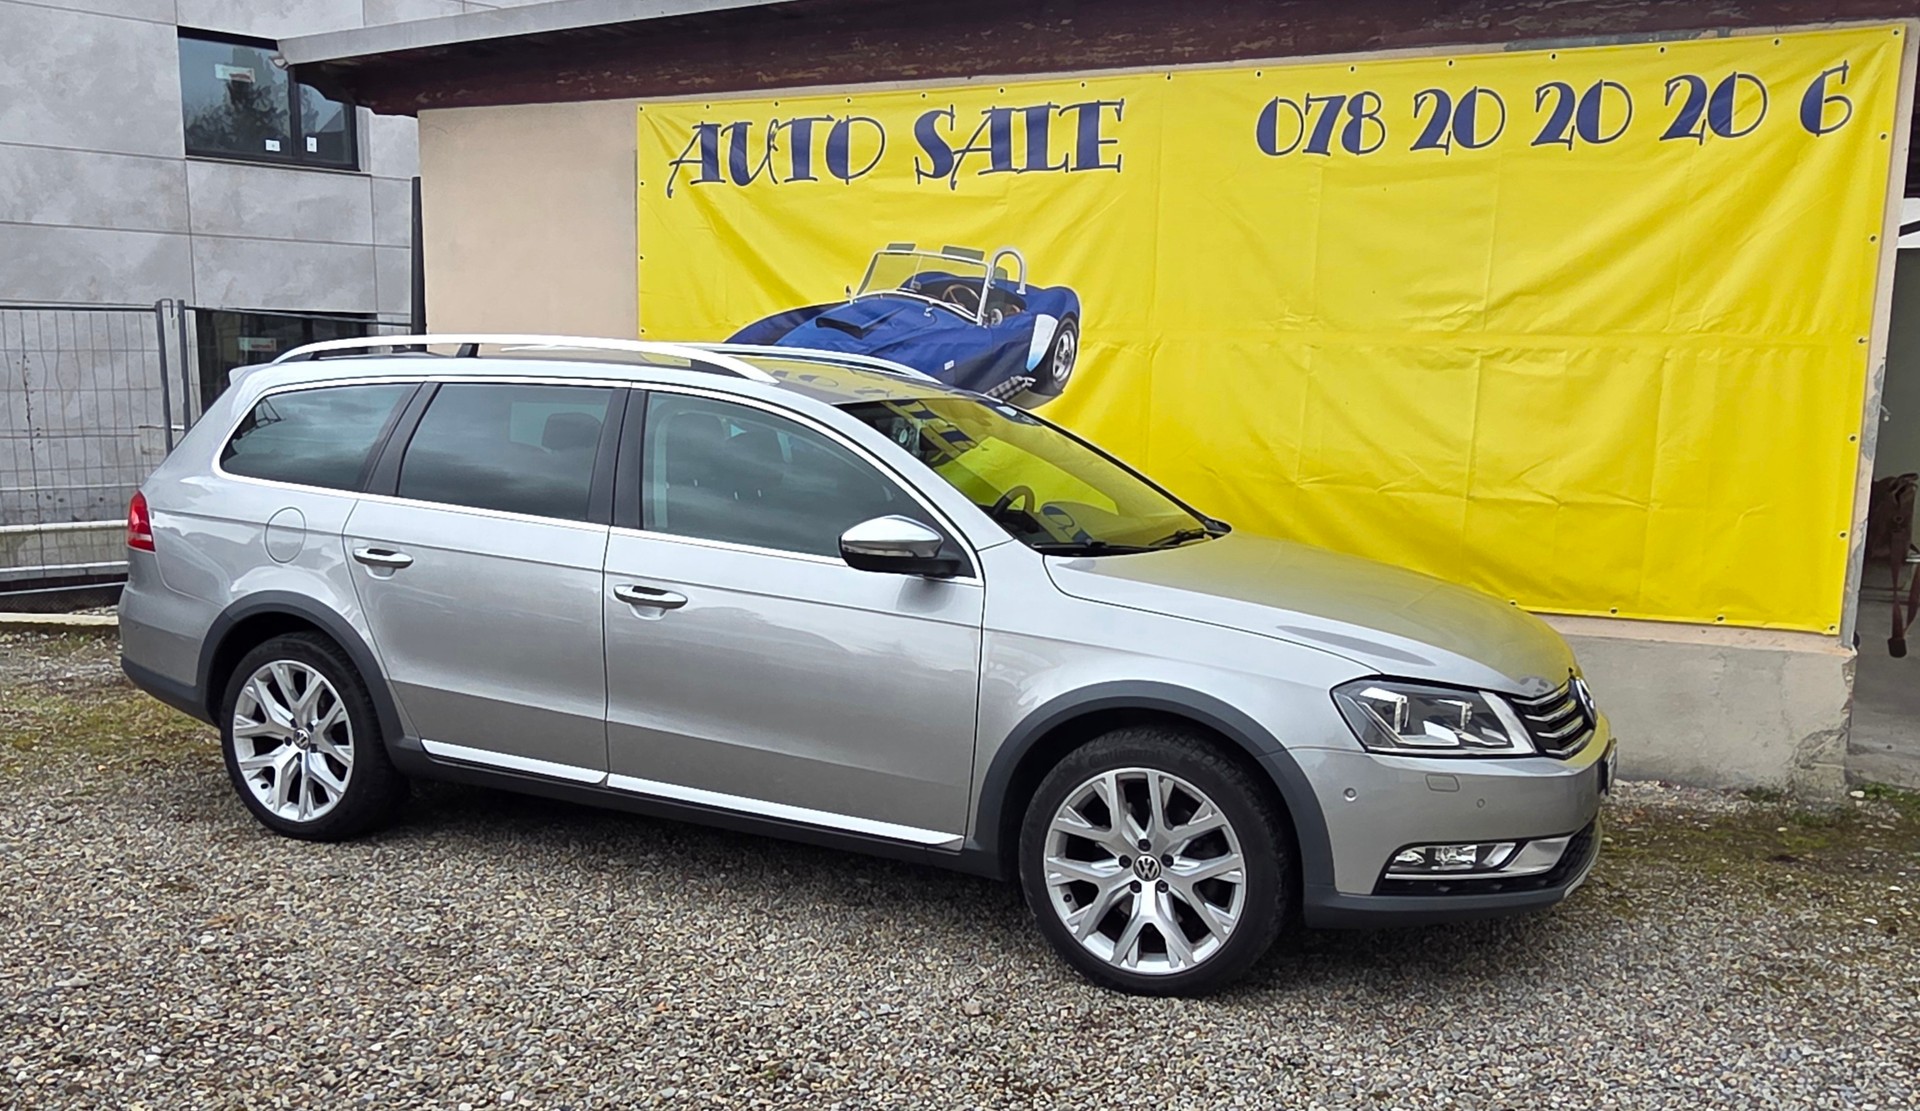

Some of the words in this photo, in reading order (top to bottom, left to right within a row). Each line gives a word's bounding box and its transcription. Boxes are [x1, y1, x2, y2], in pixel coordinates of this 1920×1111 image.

[667, 114, 886, 199] AUTO
[914, 98, 1125, 191] SALE
[1256, 91, 1386, 157] 078
[1409, 86, 1506, 156] 20
[1530, 79, 1633, 151] 20
[1658, 71, 1768, 146] 20
[1799, 60, 1852, 137] 6
